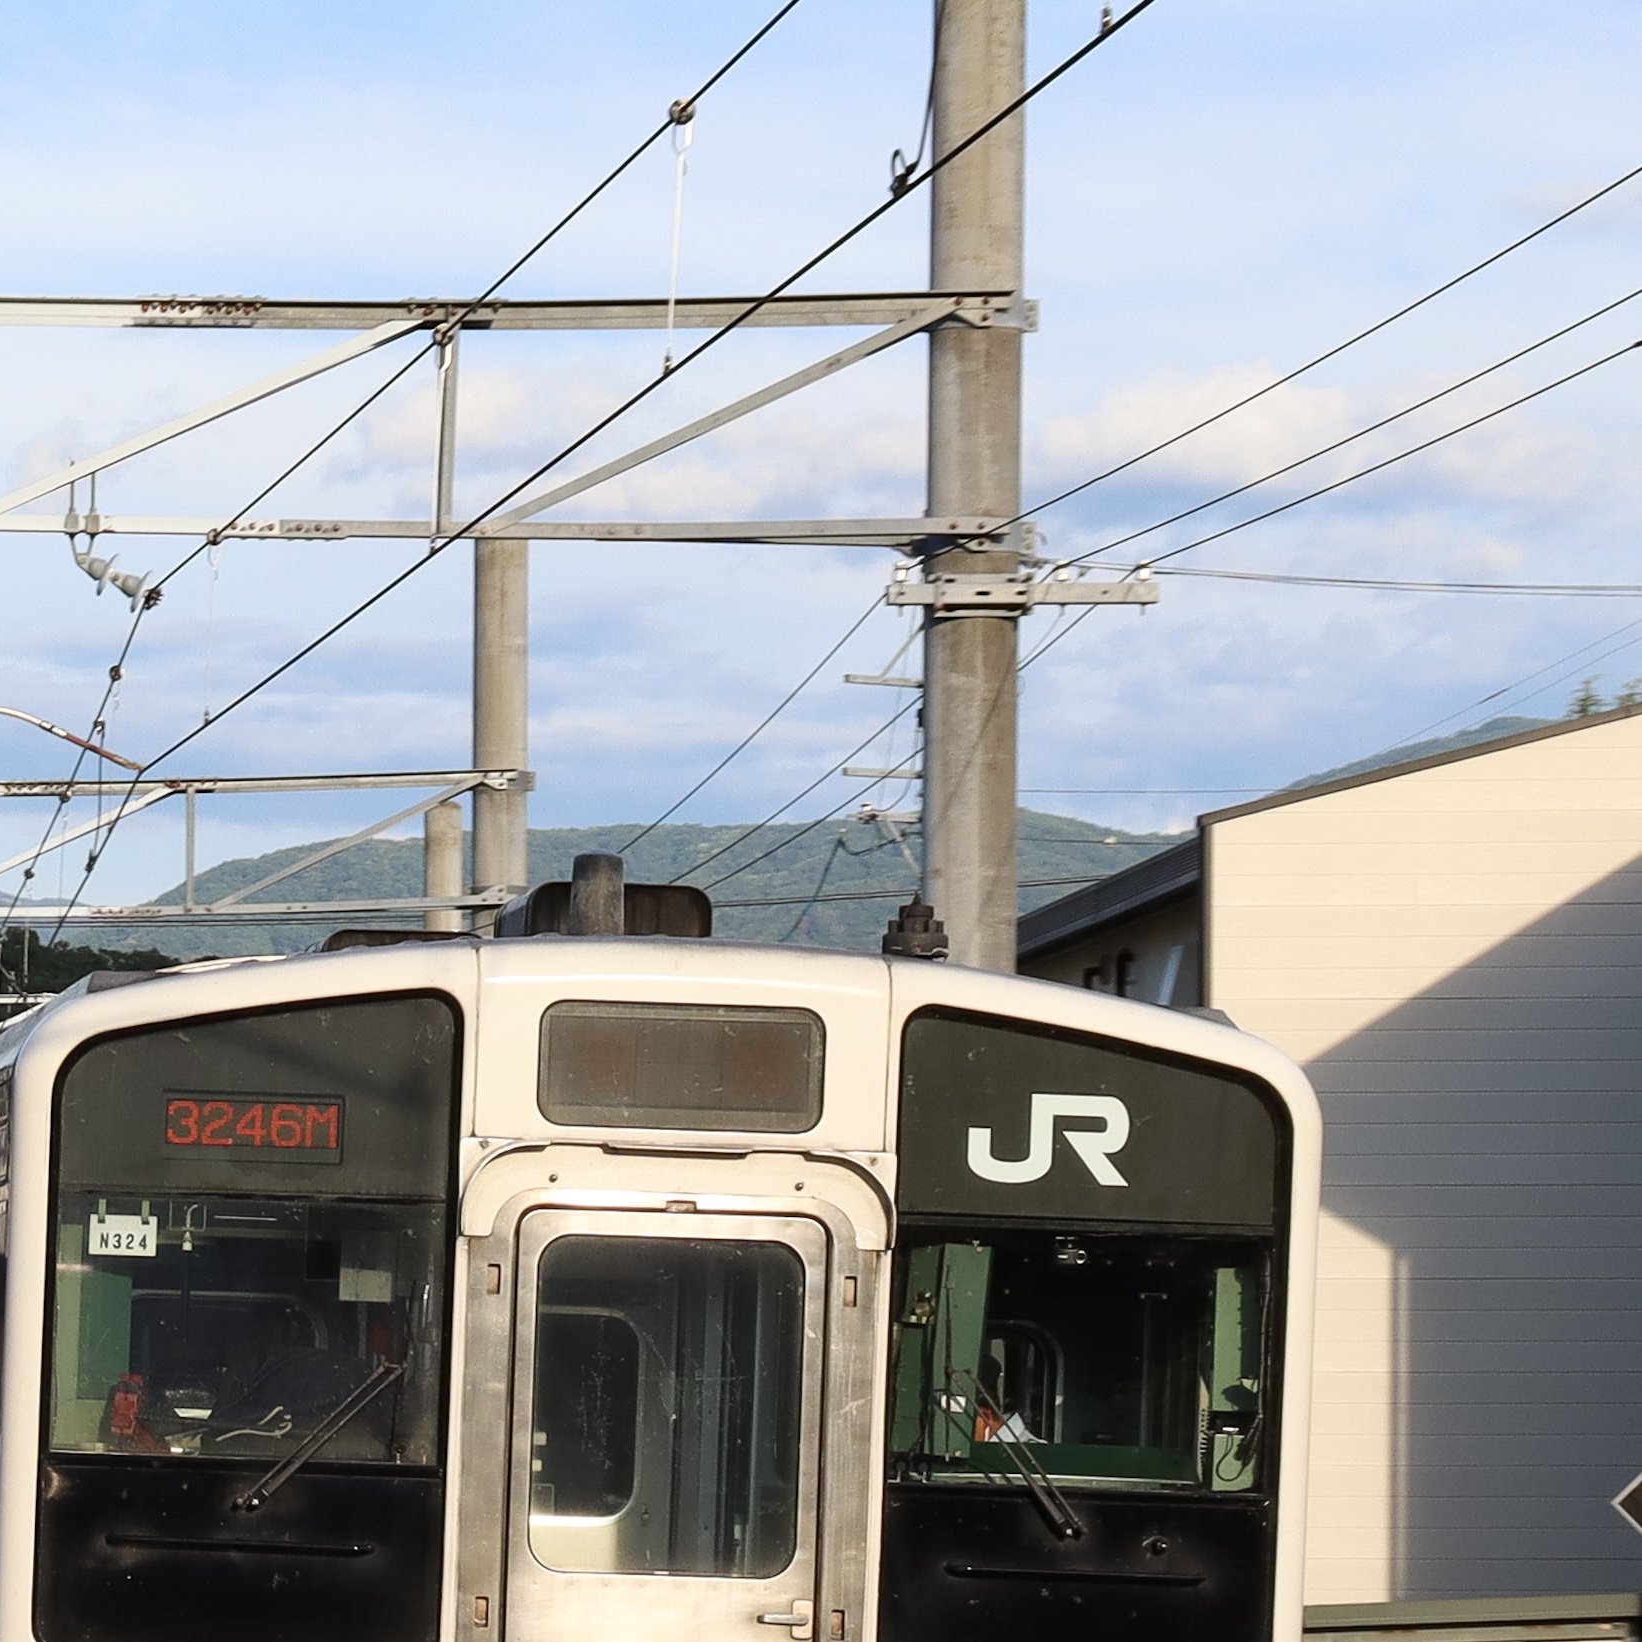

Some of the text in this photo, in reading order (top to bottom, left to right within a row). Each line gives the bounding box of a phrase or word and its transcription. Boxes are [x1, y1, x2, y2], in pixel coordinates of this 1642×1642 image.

[167, 1100, 339, 1149] 3246M
[968, 1094, 1130, 1187] JR
[99, 1232, 147, 1251] N324
